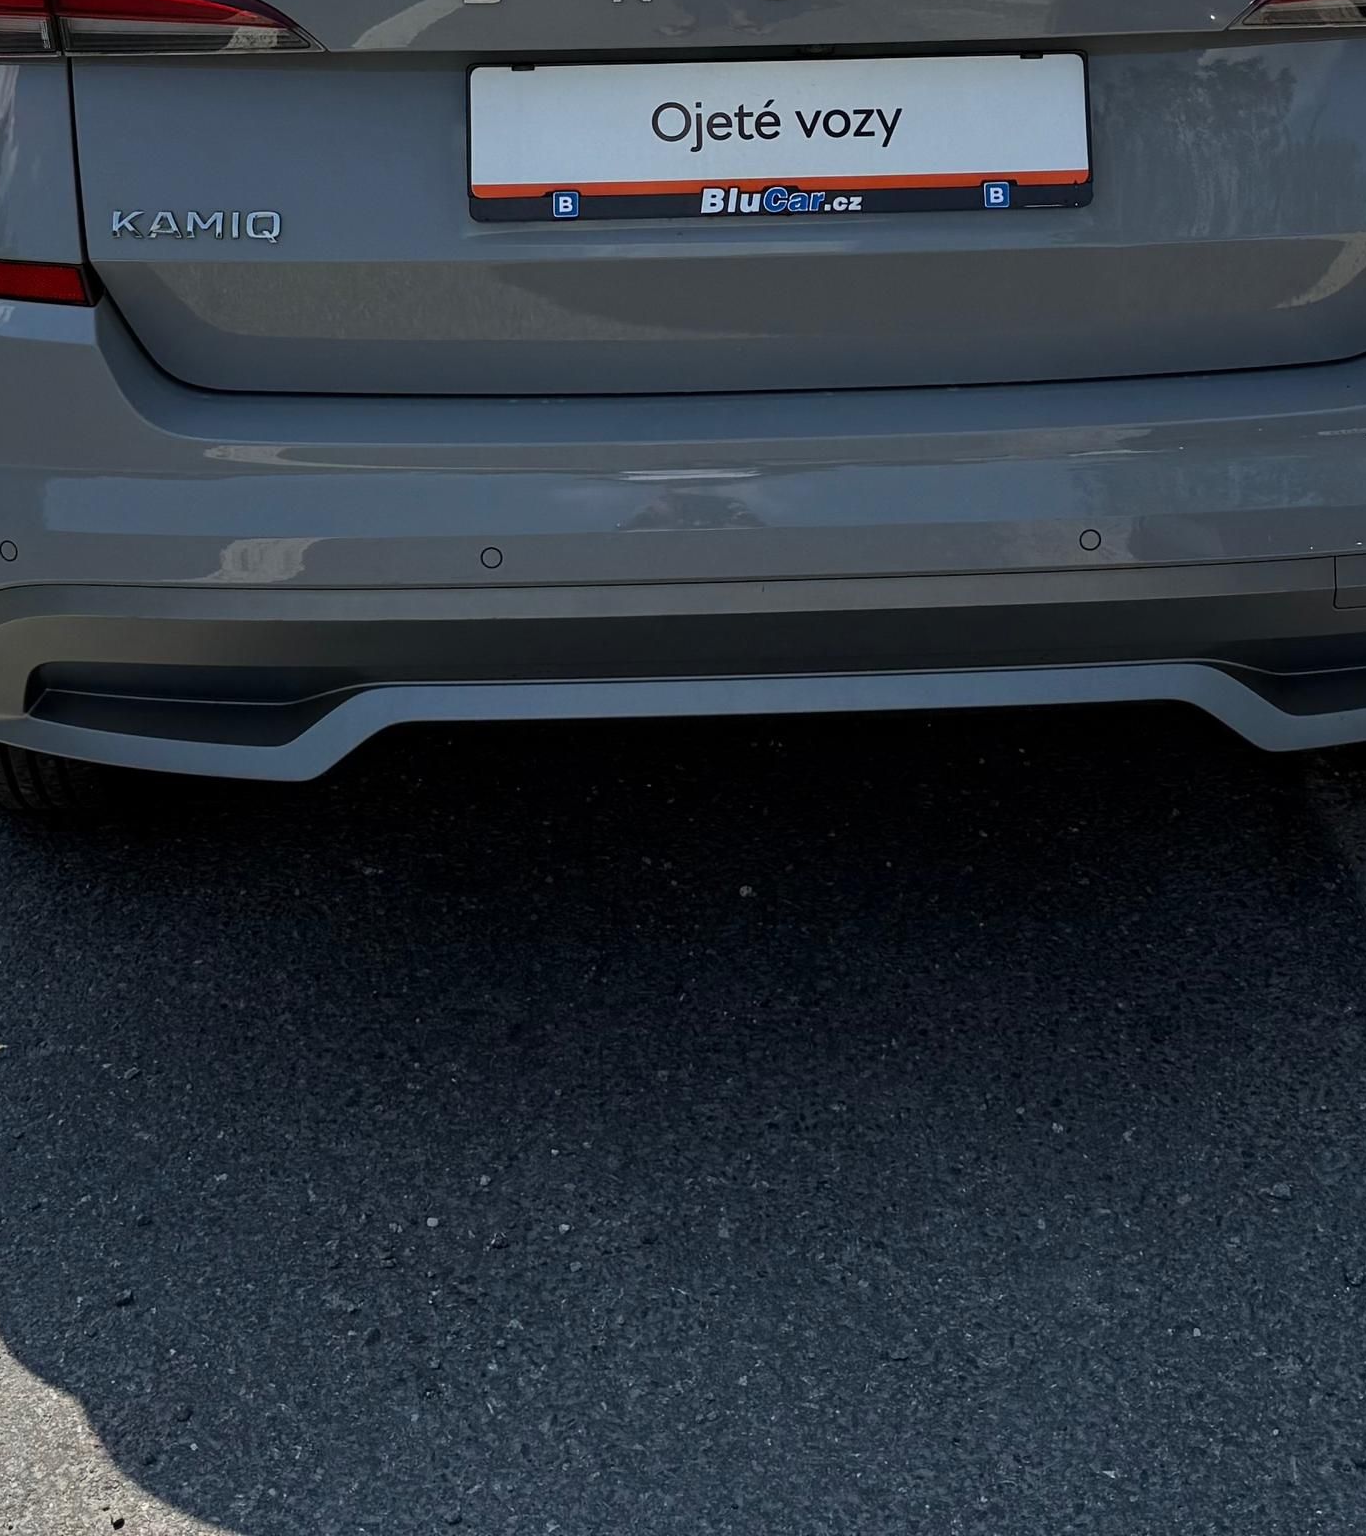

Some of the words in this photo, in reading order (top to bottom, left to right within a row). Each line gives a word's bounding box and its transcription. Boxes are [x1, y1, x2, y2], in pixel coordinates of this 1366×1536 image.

[651, 98, 782, 153] Ojeté
[794, 107, 903, 148] vozy
[558, 196, 574, 212] B
[700, 186, 862, 214] BluCar.cz
[989, 187, 1005, 203] B
[112, 210, 282, 244] KAMIQ
